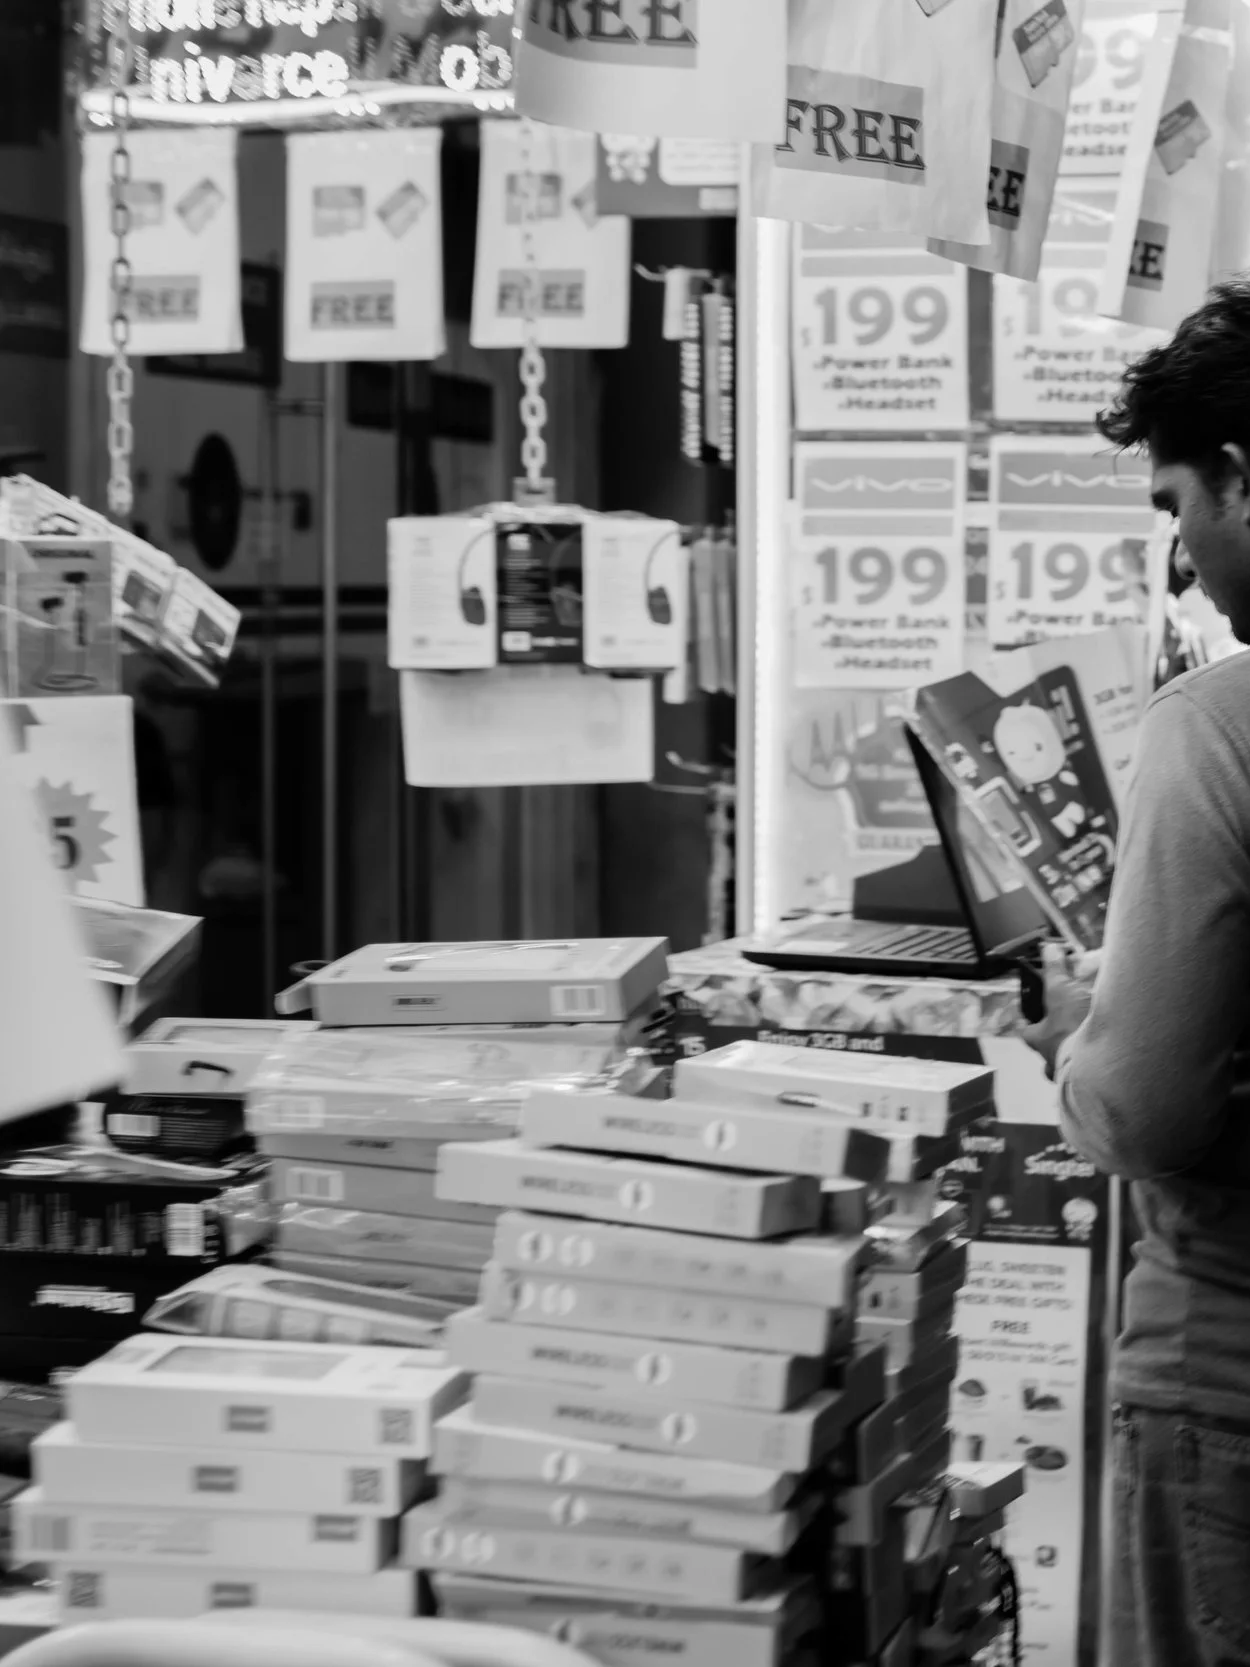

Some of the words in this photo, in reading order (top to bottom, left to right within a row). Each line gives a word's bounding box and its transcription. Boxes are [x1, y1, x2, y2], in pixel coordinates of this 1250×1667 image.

[776, 98, 926, 170] FREE
[311, 291, 393, 327] FREE
[898, 353, 953, 370] Bank
[897, 613, 950, 630] Bank
[848, 1036, 884, 1051] and
[990, 1319, 1031, 1334] FREE
